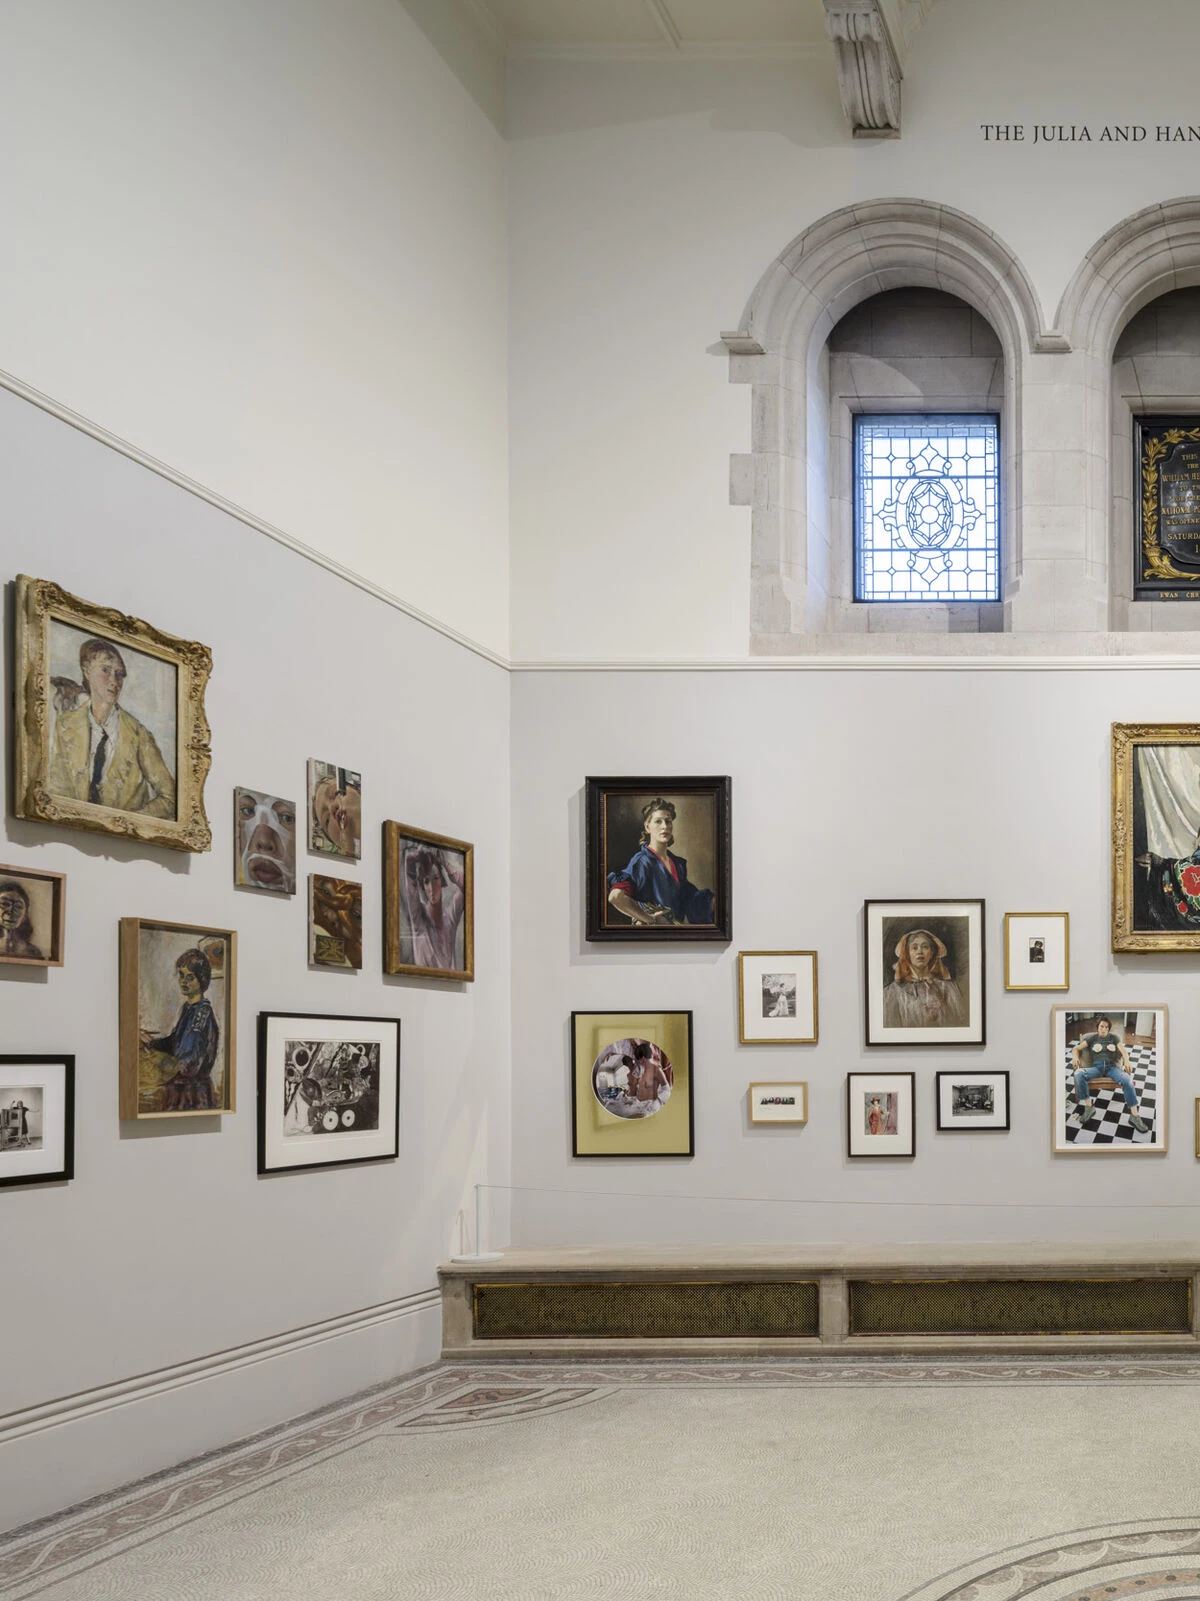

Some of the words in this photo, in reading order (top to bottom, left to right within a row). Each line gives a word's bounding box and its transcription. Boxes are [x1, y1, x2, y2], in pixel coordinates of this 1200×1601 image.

[980, 125, 1024, 141] THE
[1033, 125, 1092, 144] JULIA
[1100, 126, 1147, 141] AND
[1161, 473, 1190, 482] WILLIAM
[1161, 506, 1190, 515] NATIONAL
